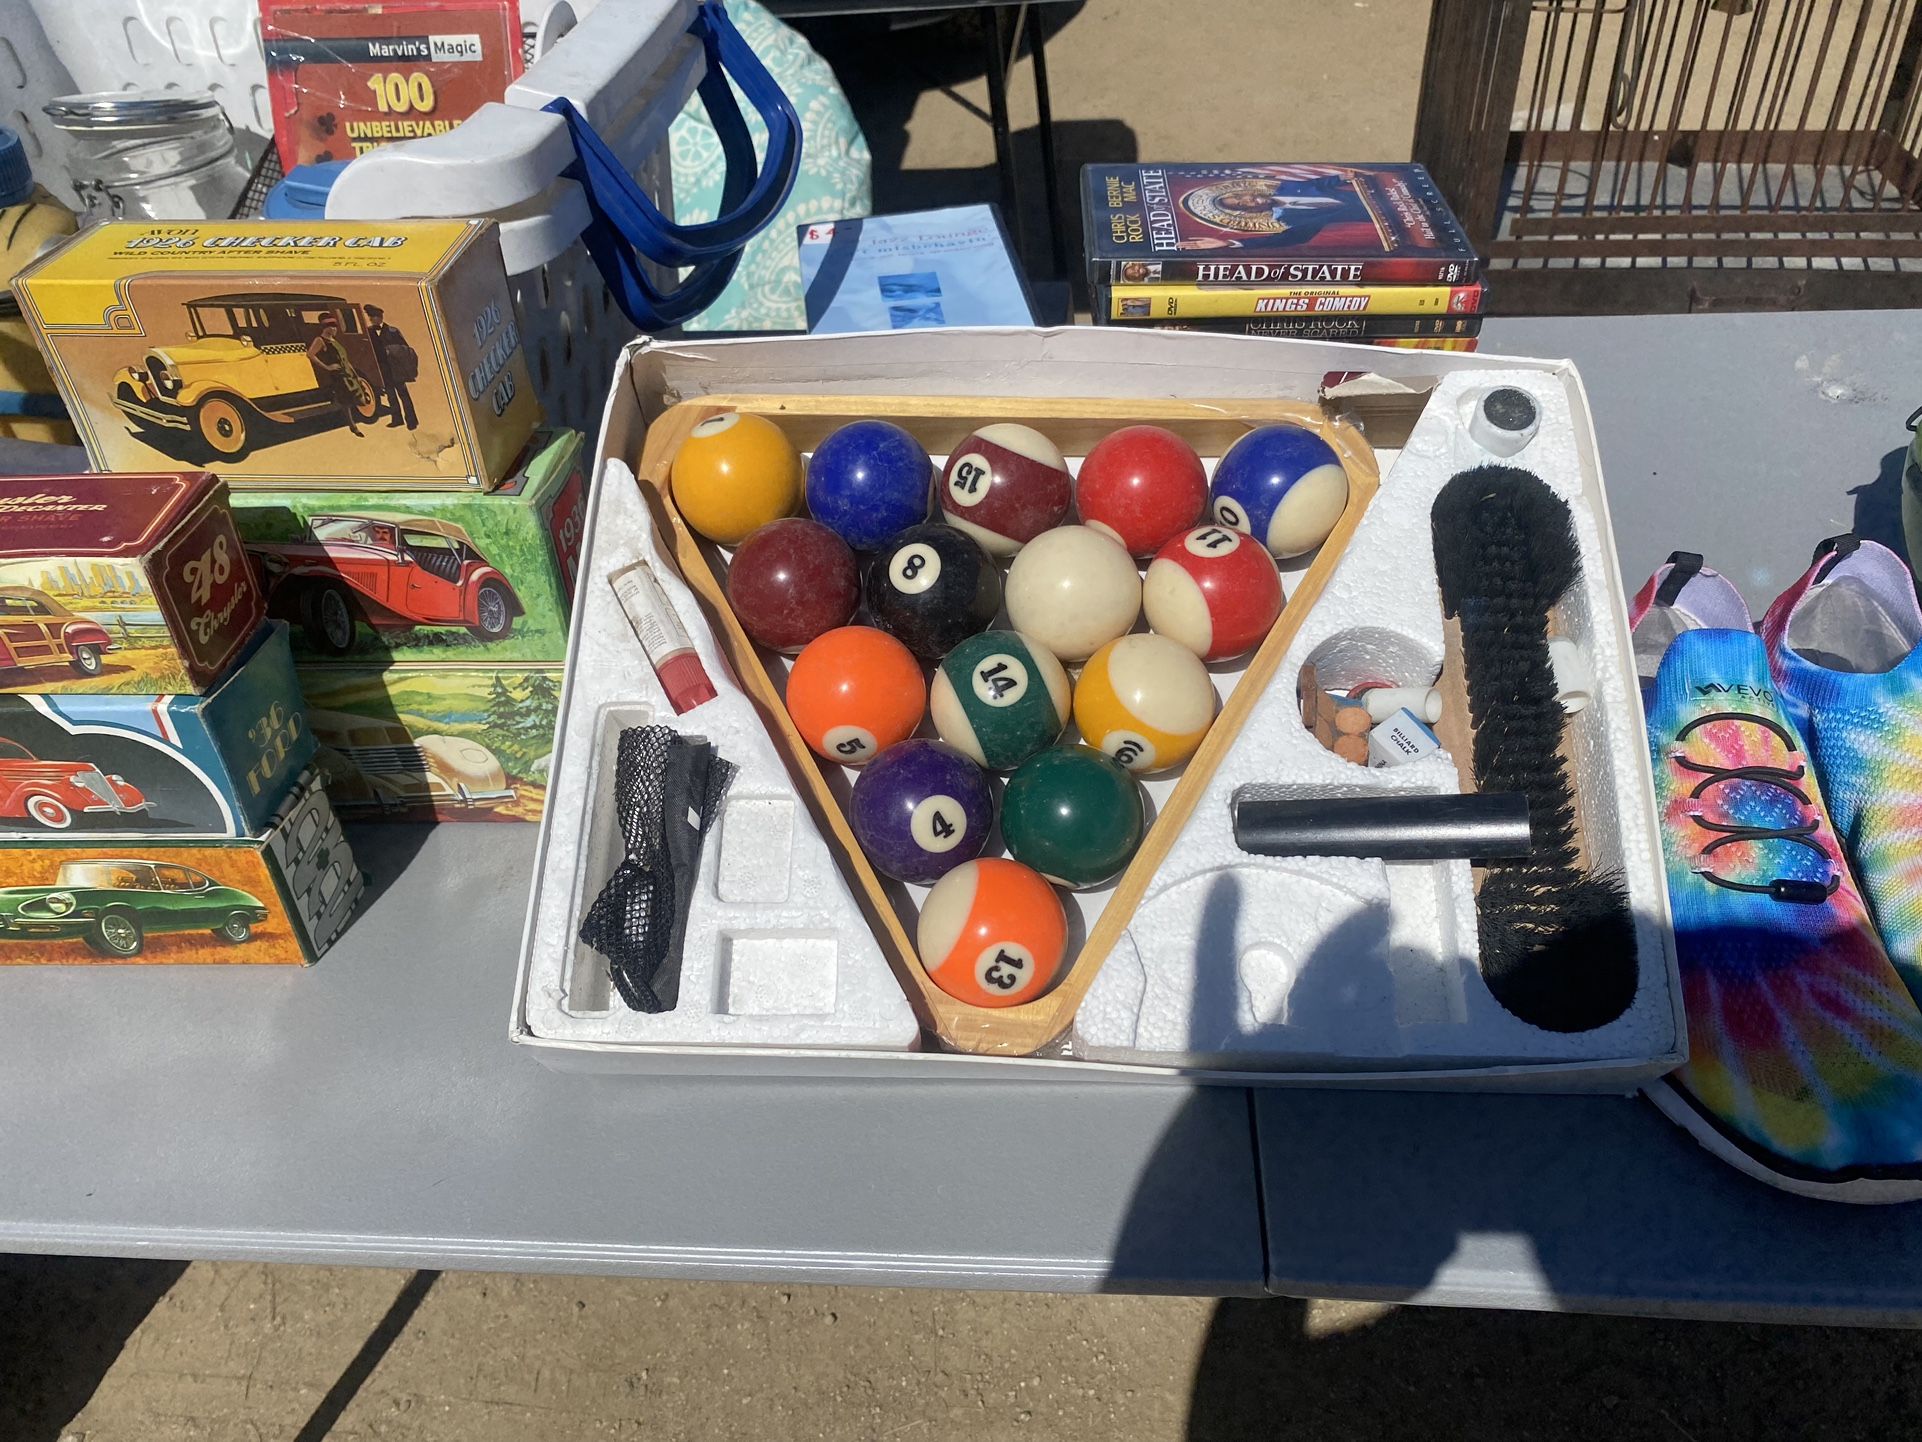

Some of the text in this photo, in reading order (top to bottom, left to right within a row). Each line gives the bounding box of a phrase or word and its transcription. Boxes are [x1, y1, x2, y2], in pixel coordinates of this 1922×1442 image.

[368, 40, 477, 57] Marvin's Magic
[367, 72, 435, 113] 100
[1141, 169, 1168, 204] STATE
[1105, 176, 1127, 244] CHRIS BERNIE
[1121, 181, 1144, 242] ROCK MAC
[126, 236, 408, 249] 1926 CHECKER CAB
[1149, 210, 1178, 252] HEAD
[1196, 264, 1363, 283] HEAD of STATE
[1446, 264, 1455, 282] DVD
[1255, 297, 1369, 312] KINGS COMEDY
[473, 299, 501, 349] 1926
[468, 320, 520, 401] CHECKER
[492, 371, 515, 417] CAB
[953, 461, 986, 494] 15
[1219, 506, 1240, 527] 0
[1195, 528, 1233, 549] 11
[182, 534, 231, 607] 48
[902, 554, 926, 580] 8
[190, 580, 247, 645] Chrysler
[980, 662, 1018, 700] 14
[246, 711, 303, 798] FORD
[835, 737, 866, 755] 5
[1390, 734, 1412, 756] CHALK
[1392, 727, 1420, 754] BILLIARD
[932, 810, 955, 839] 4
[984, 949, 1024, 990] 13
